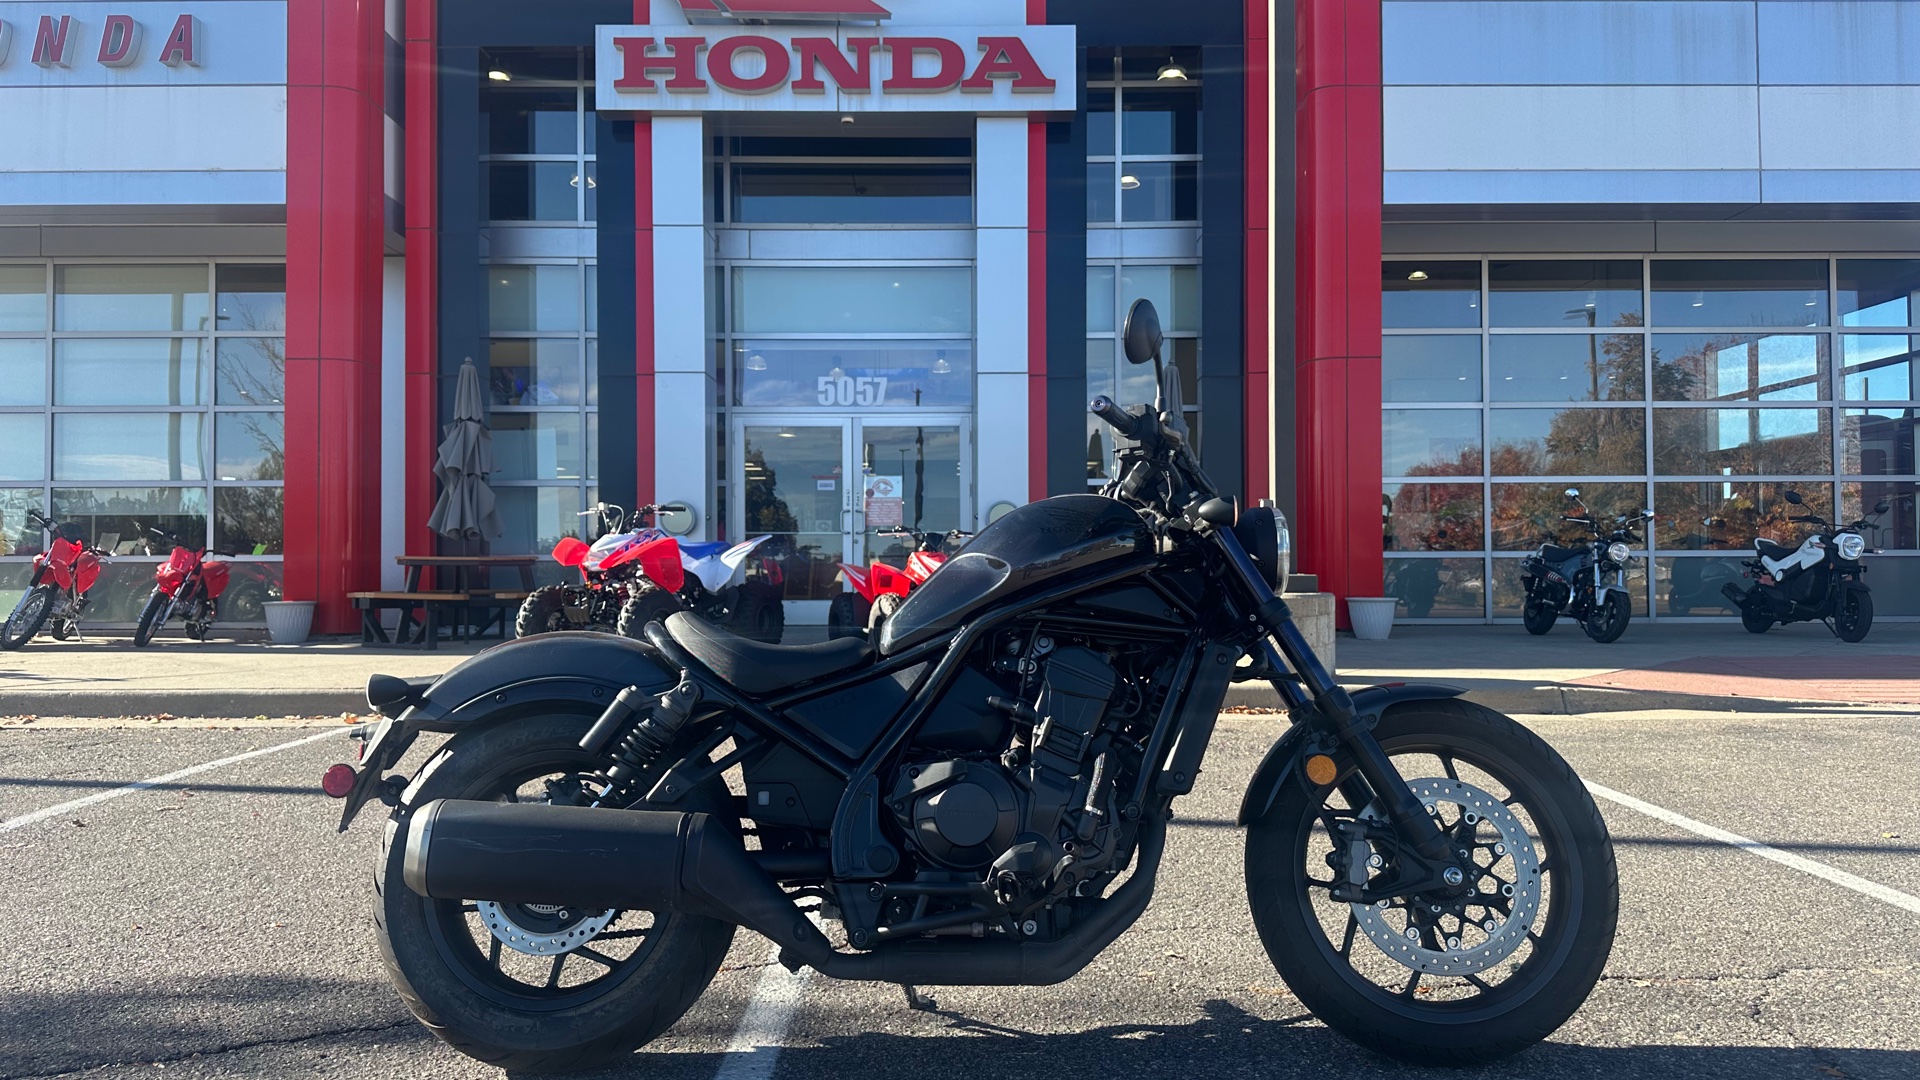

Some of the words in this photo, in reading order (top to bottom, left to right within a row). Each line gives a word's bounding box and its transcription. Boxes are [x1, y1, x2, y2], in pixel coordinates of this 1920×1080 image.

[0, 14, 200, 68] NDA
[612, 34, 1057, 95] HONDA
[816, 376, 888, 406] 5057
